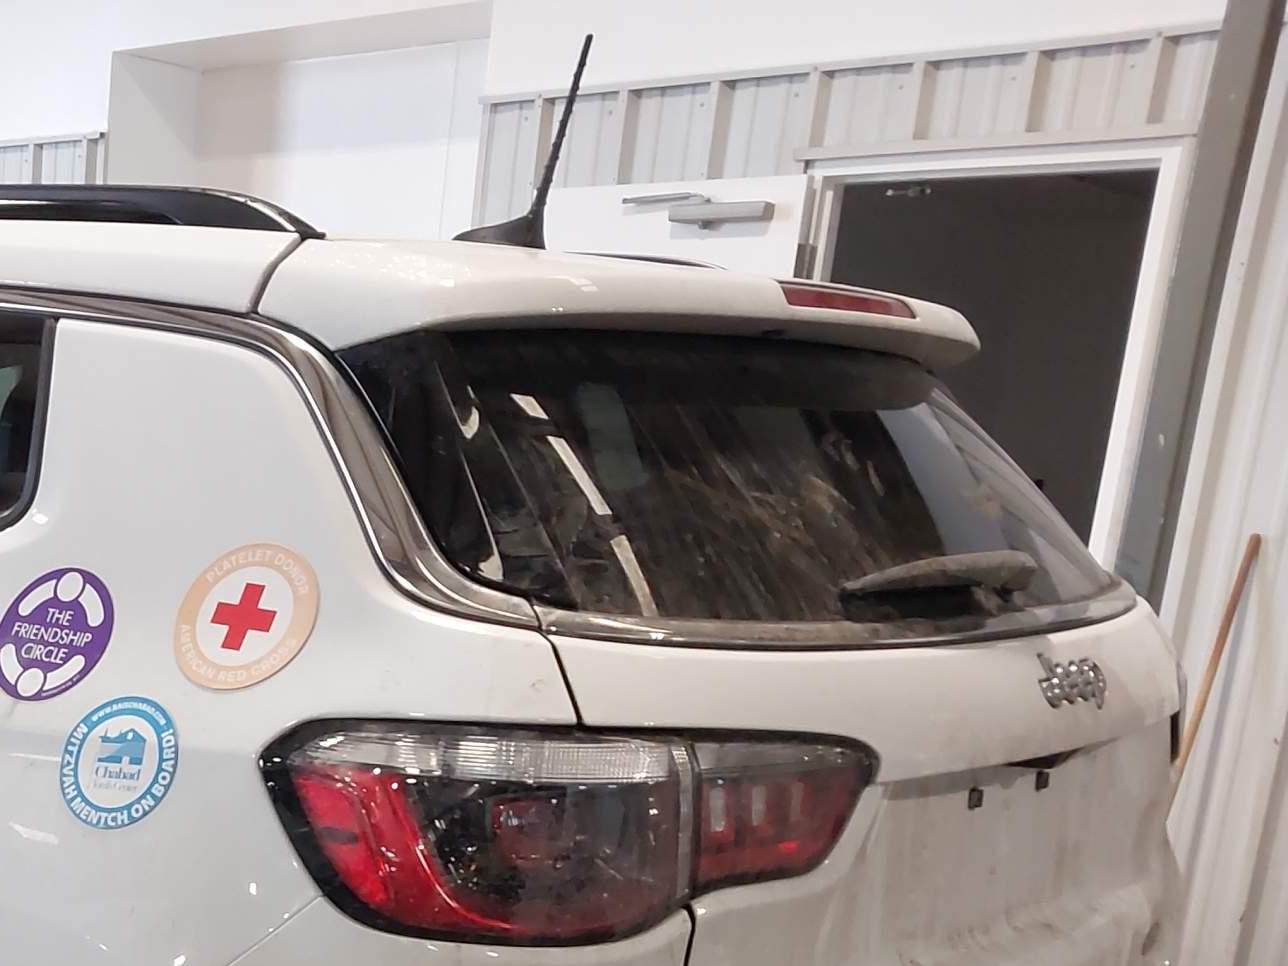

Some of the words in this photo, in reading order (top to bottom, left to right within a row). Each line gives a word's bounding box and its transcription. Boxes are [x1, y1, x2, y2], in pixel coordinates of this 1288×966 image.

[206, 550, 272, 583] PLATELET
[46, 607, 74, 626] THE
[11, 621, 93, 647] FRIENDSHIP
[21, 642, 69, 664] CIRCLE
[216, 670, 247, 682] RED
[62, 723, 89, 799] MITZVAH
[70, 797, 130, 826] MENTCH
[131, 795, 155, 818] ON
